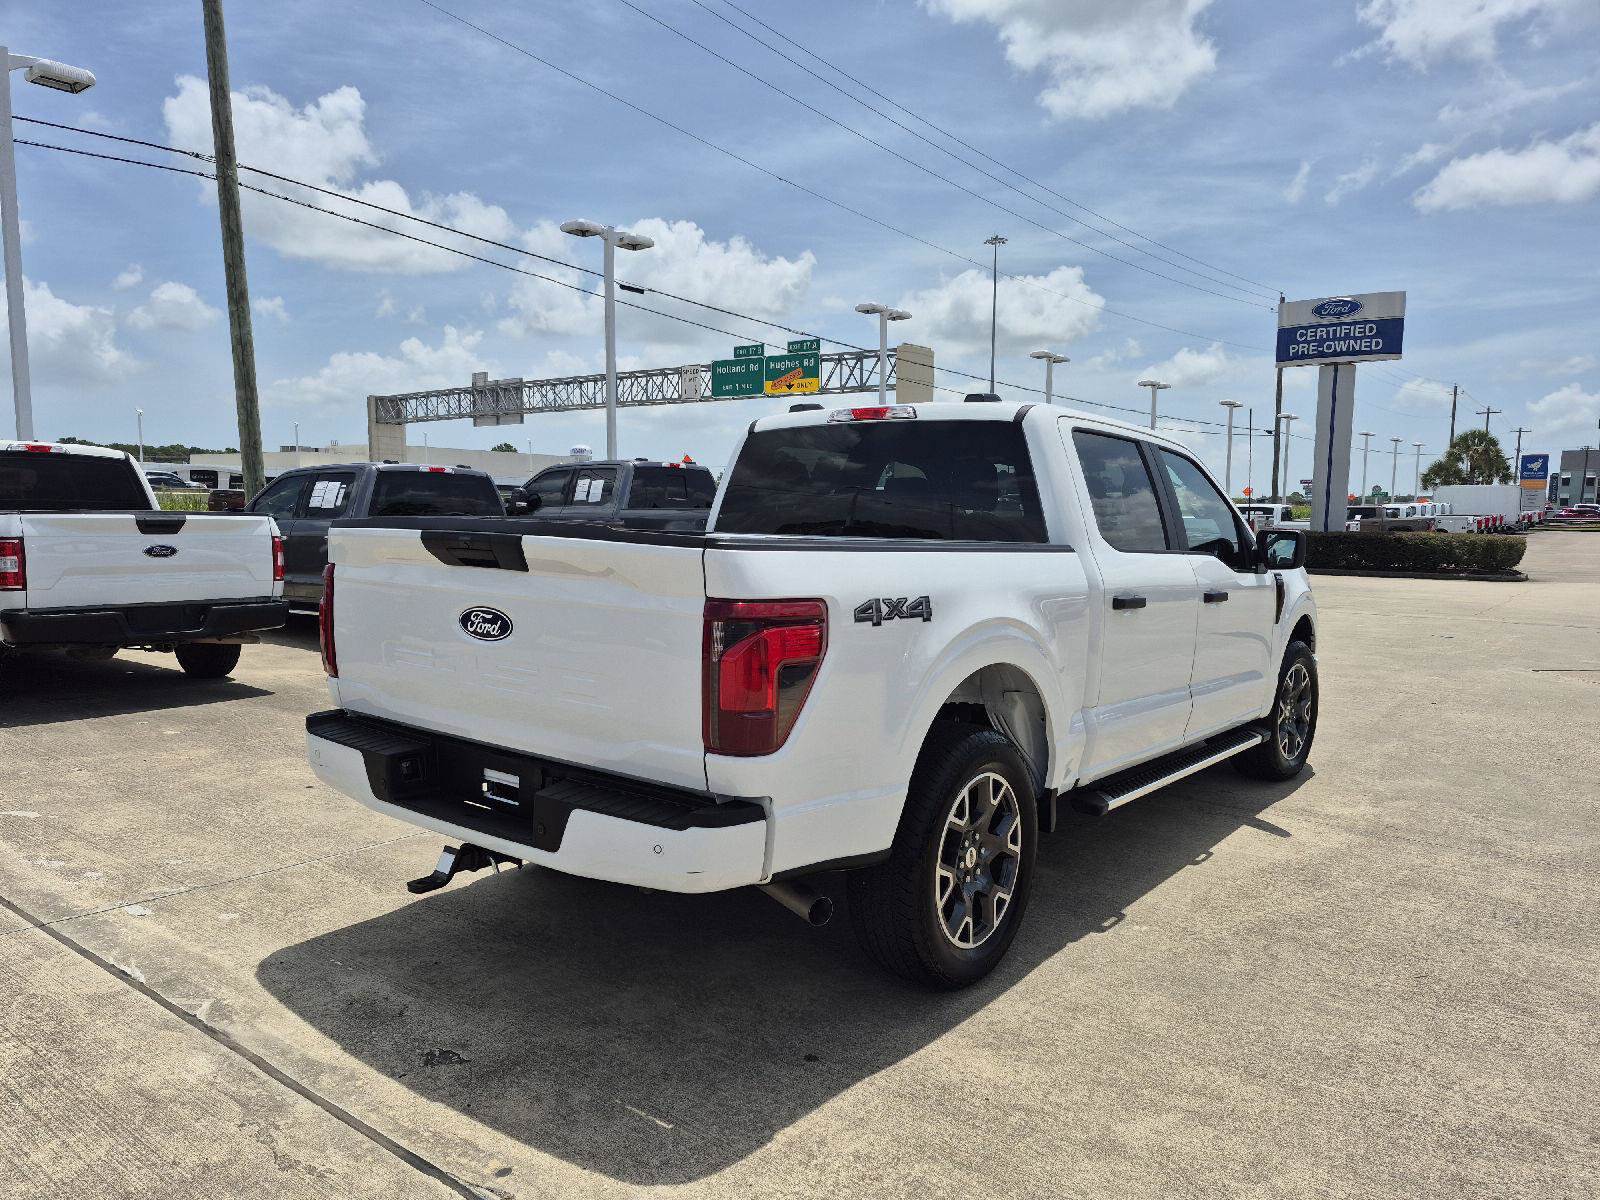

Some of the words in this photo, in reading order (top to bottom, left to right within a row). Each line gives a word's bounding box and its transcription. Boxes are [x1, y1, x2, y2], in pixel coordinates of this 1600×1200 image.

[1321, 301, 1351, 315] Ford
[1296, 323, 1377, 342] CERTIFIED
[749, 347, 757, 355] 17
[803, 341, 811, 350] 17
[812, 341, 818, 349] A
[1289, 338, 1383, 357] PRE-OWNED
[716, 364, 746, 374] Holland
[749, 363, 759, 372] Rd
[770, 360, 800, 371] Hughes
[803, 358, 814, 367] Rd
[796, 381, 813, 389] ONLY
[467, 611, 502, 636] Ford
